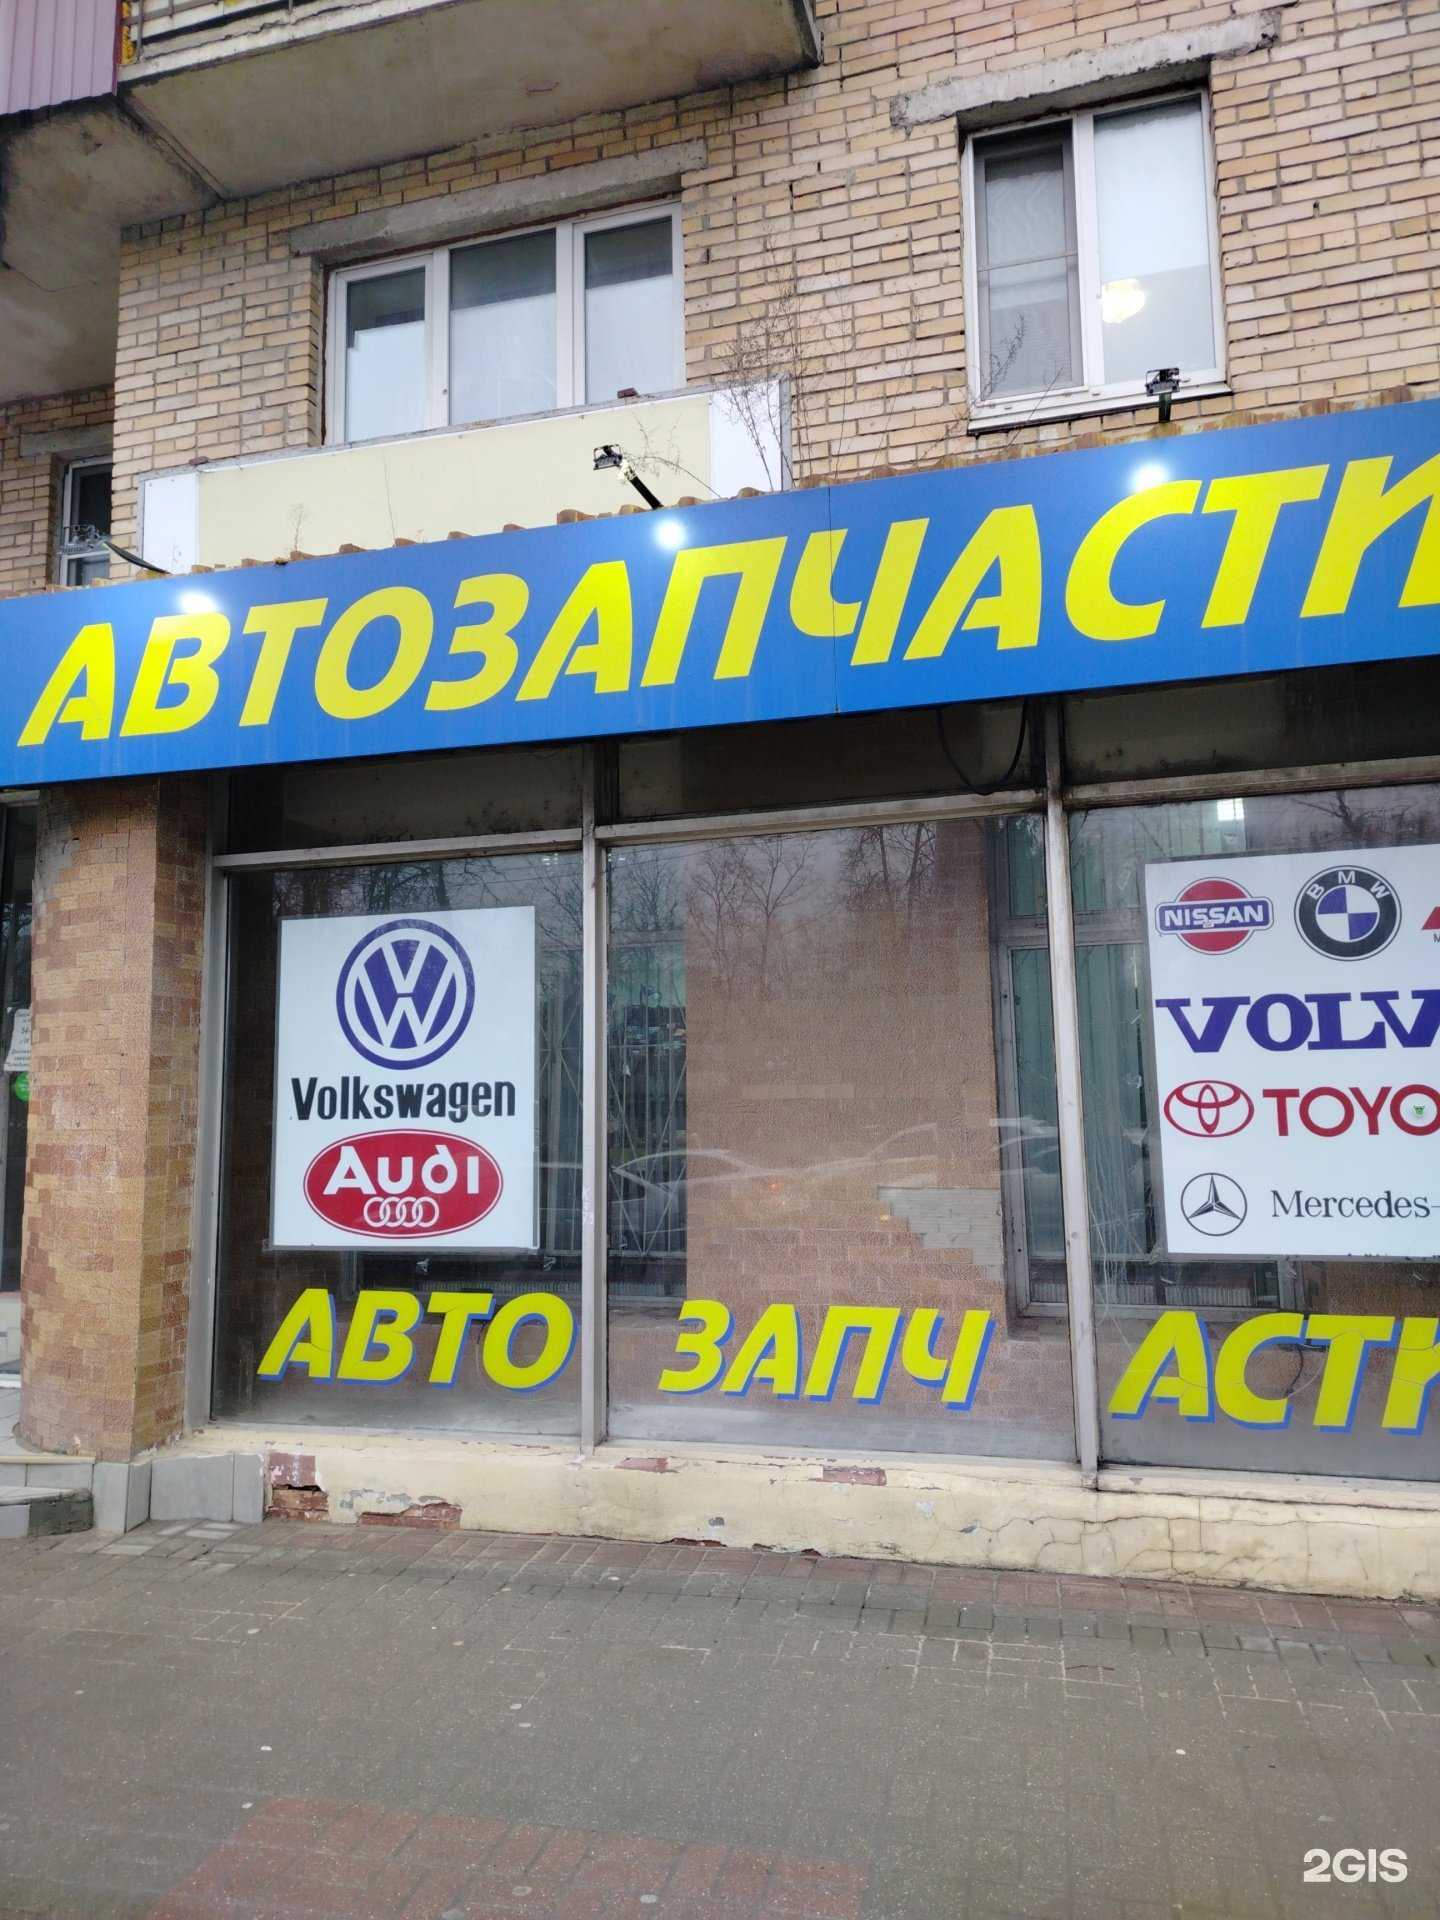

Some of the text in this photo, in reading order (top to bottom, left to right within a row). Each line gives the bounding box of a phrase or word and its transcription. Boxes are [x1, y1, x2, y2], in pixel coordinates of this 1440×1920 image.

[1306, 869, 1390, 900] BMW
[1163, 902, 1265, 929] NISSAN
[1155, 989, 1440, 1053] VOLV
[290, 1075, 516, 1123] Volkswagen
[1262, 1084, 1440, 1137] TOYO
[322, 1144, 480, 1195] Audi
[257, 1288, 575, 1392] АВТО
[658, 1298, 996, 1405] ЗАПЧ
